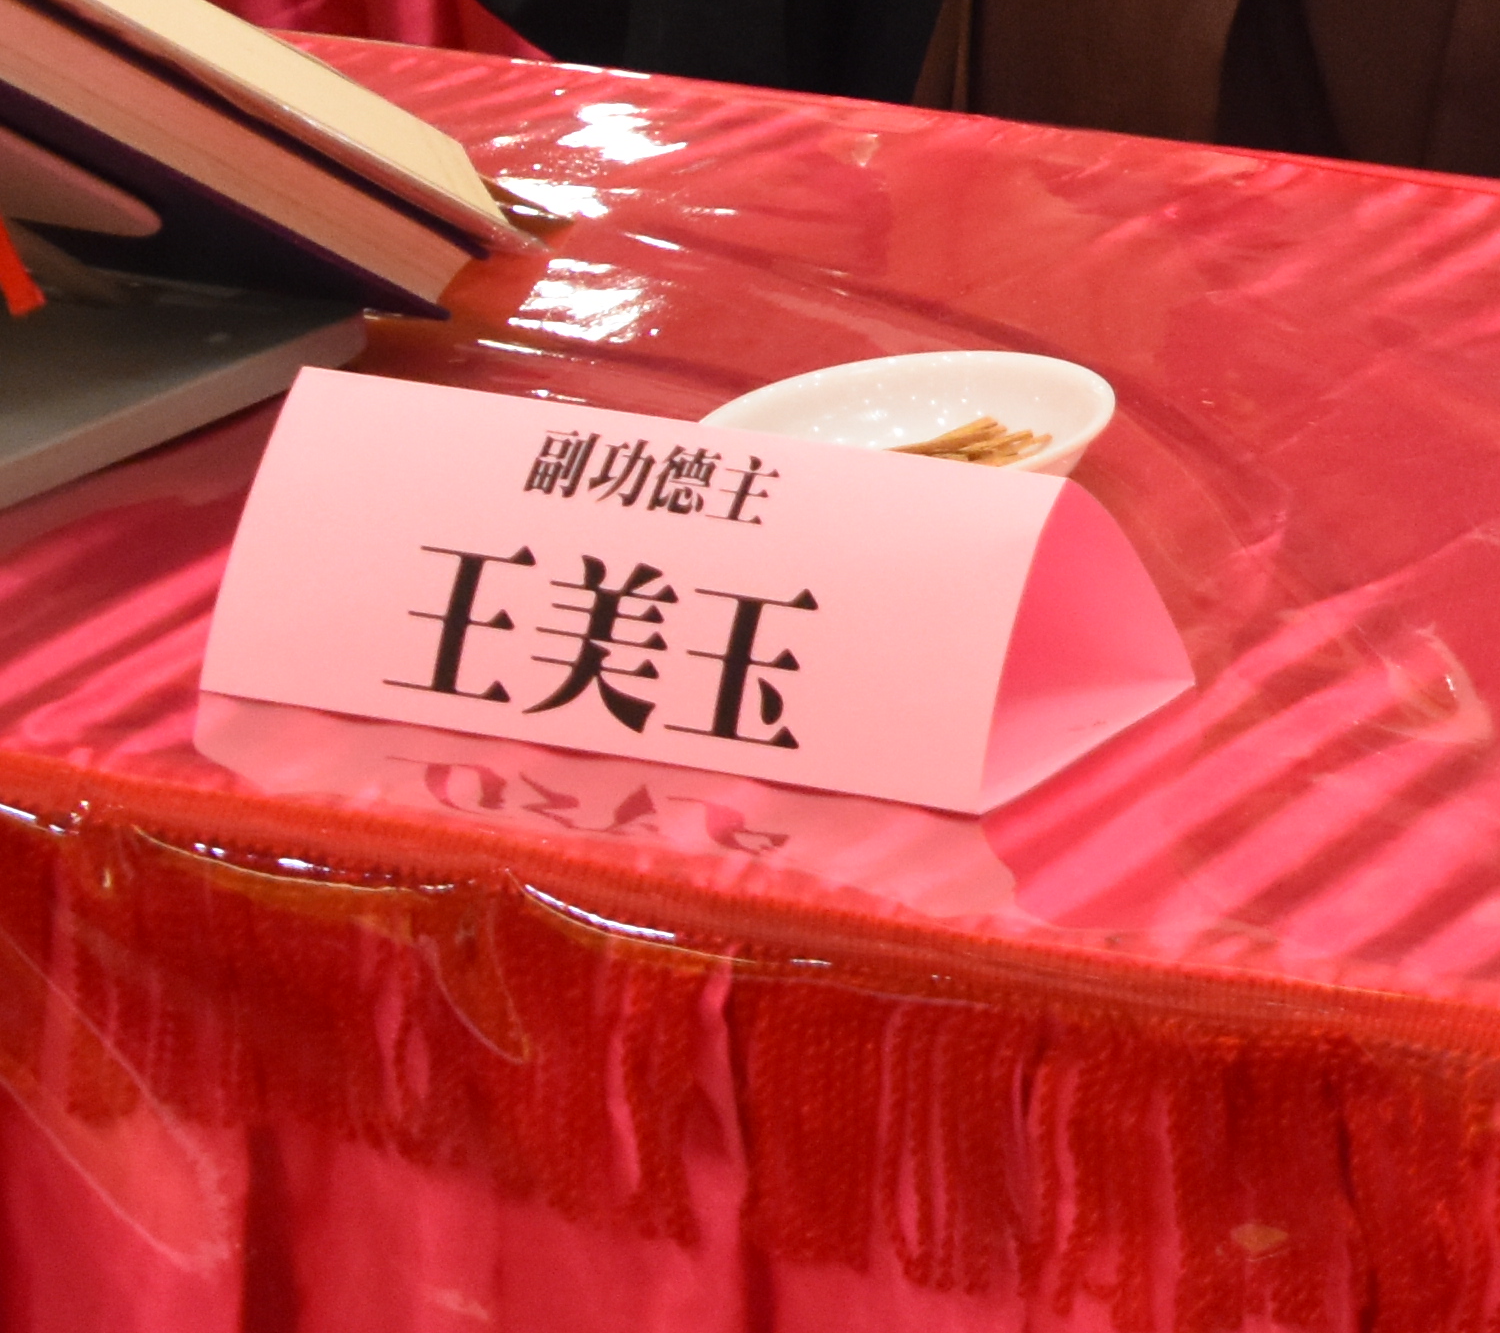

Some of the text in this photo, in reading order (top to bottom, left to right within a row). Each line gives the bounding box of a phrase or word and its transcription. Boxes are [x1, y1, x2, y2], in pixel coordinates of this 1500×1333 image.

[522, 428, 782, 527] 副功德主
[381, 544, 820, 751] 王美玉
